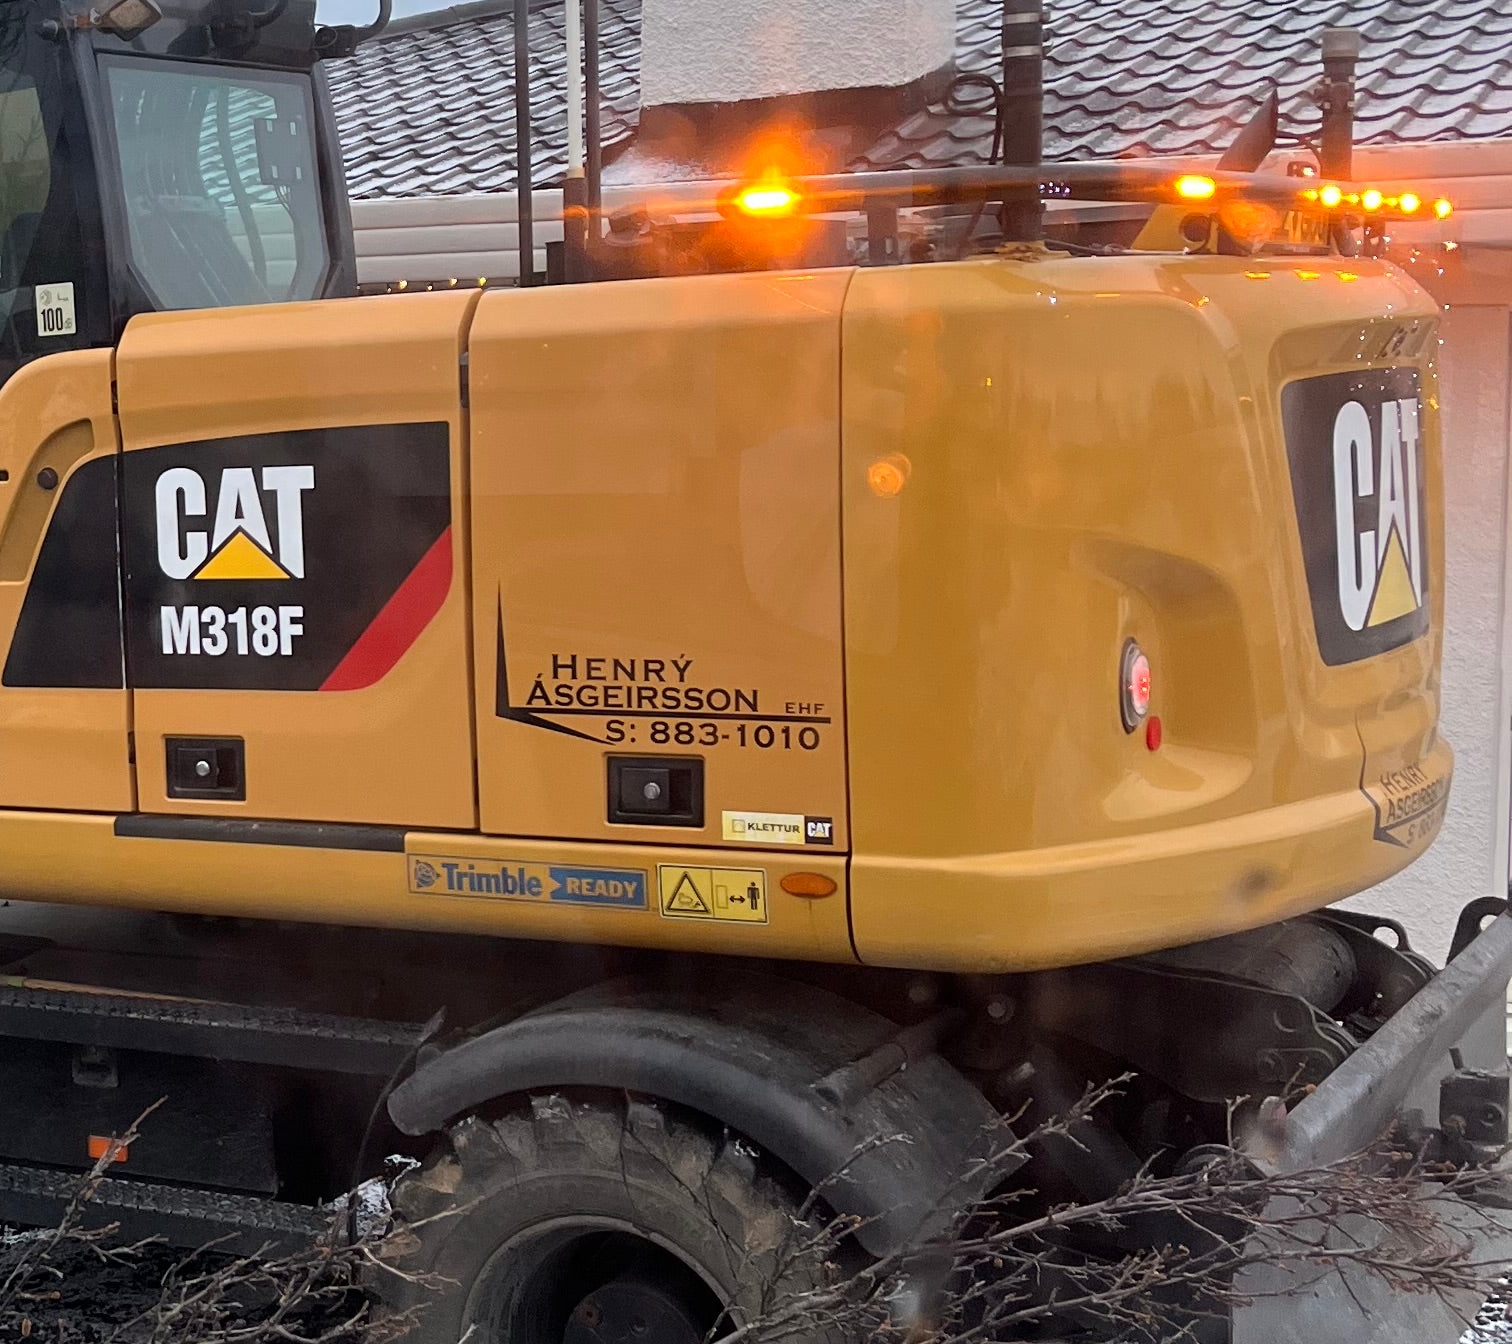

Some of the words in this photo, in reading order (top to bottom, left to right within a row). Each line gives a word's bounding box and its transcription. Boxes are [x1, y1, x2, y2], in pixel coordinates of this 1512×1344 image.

[40, 307, 64, 332] 100
[155, 465, 315, 580] CAT
[1333, 397, 1422, 632] CAT
[160, 606, 304, 656] M318F
[526, 672, 759, 712] ÁSGEIRSSON
[784, 702, 825, 715] EHF
[605, 719, 636, 743] S:
[650, 720, 821, 750] 883-1010
[747, 822, 801, 834] KLETTUR
[807, 822, 832, 838] CAT
[440, 862, 544, 897] Trimble
[566, 877, 639, 899] READY
